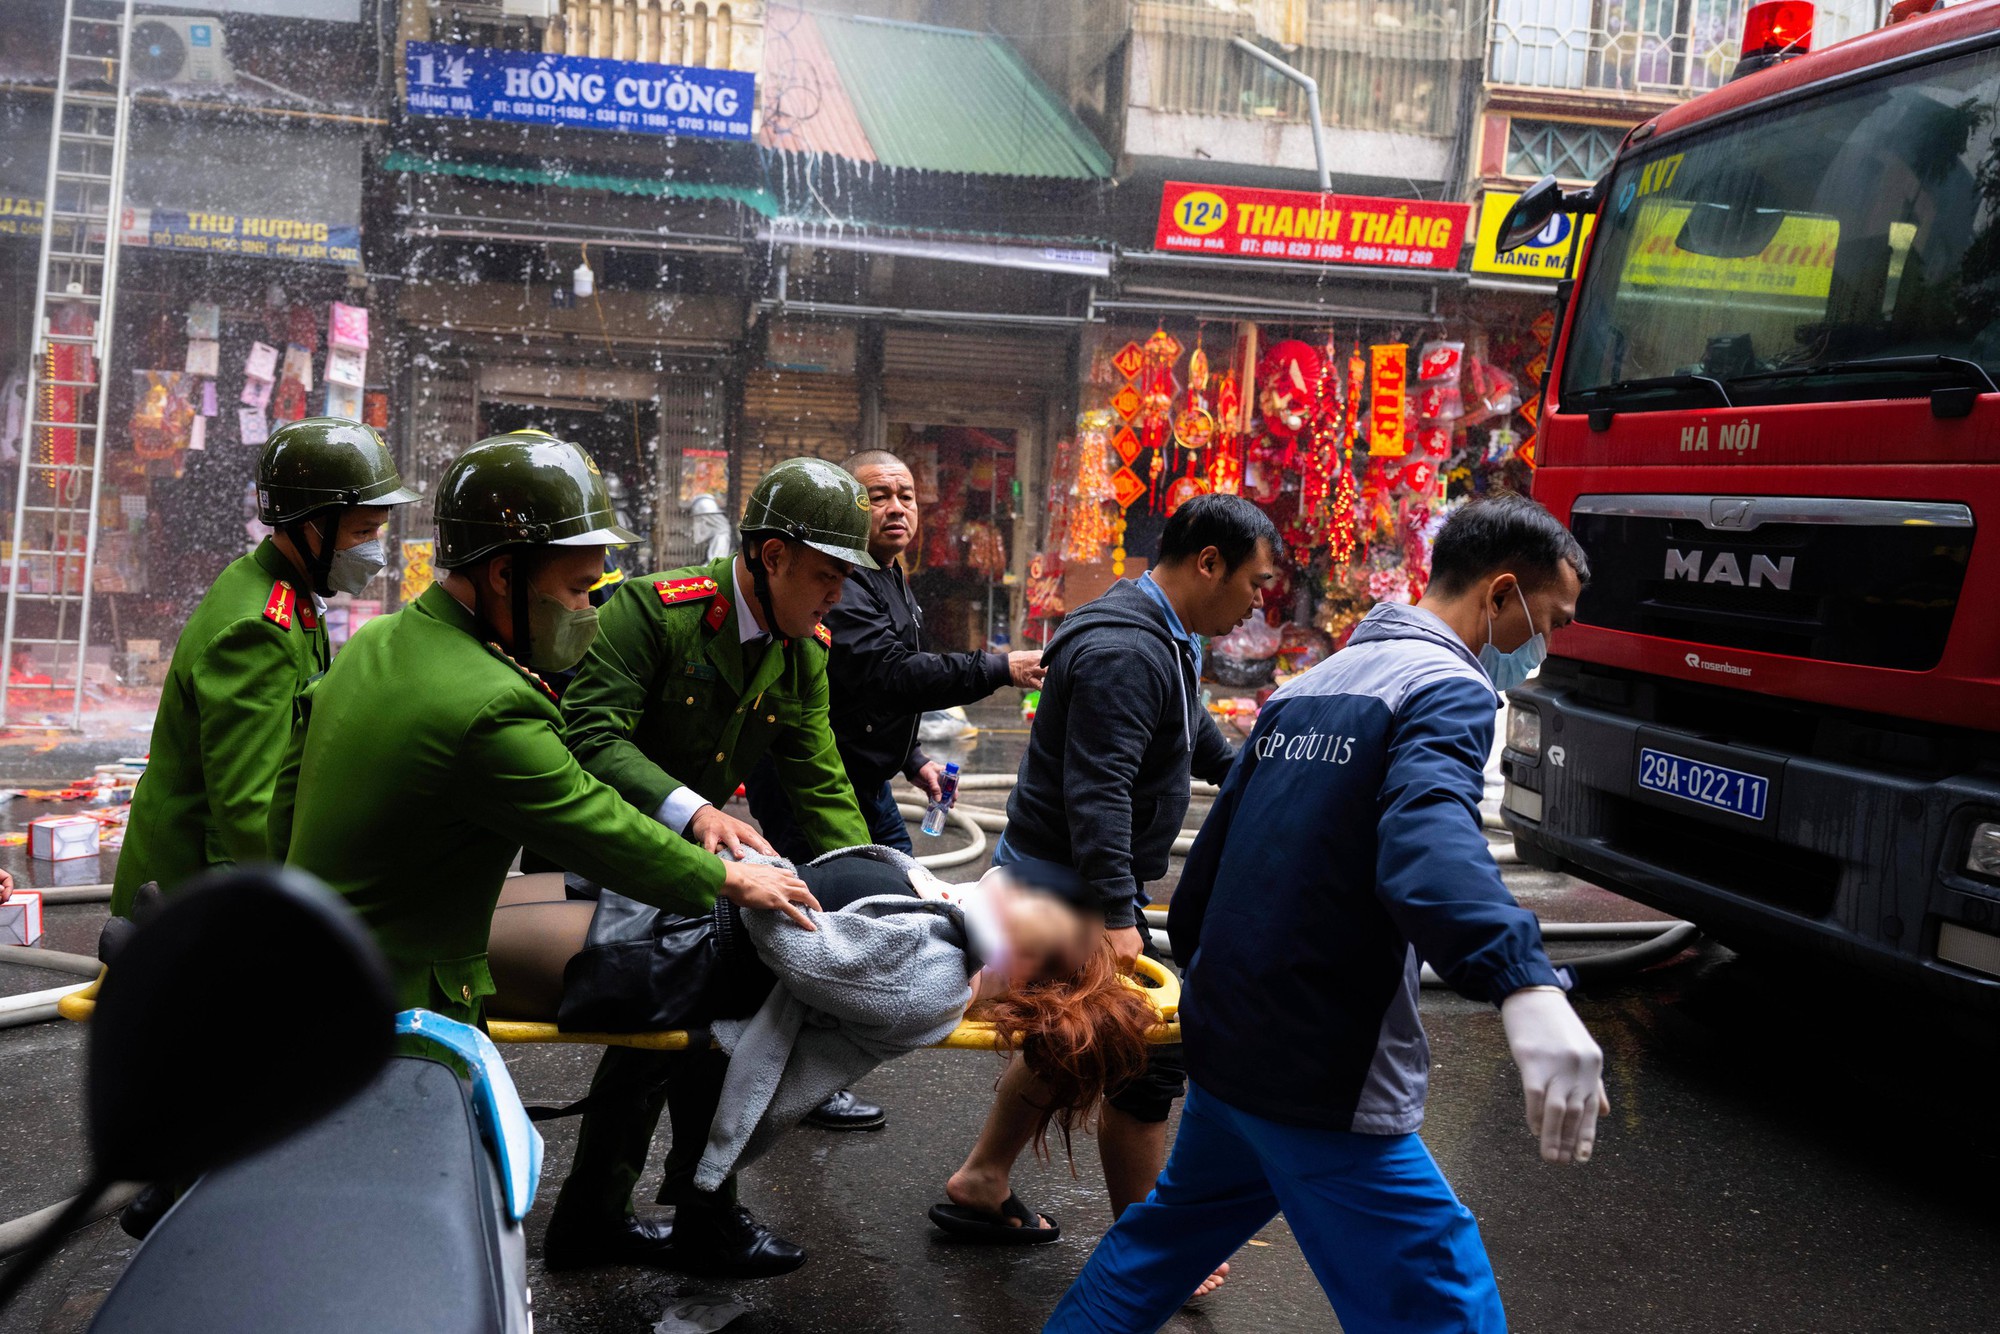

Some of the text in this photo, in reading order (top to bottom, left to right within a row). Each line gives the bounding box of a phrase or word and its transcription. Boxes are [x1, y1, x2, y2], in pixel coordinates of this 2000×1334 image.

[614, 72, 739, 117] CƯỜNG
[1637, 153, 1685, 198] KV7
[1184, 201, 1453, 249] 12A THANH THẮNG
[1680, 417, 1760, 456] HÀ NỘI
[1664, 549, 1795, 591] MAN
[1700, 660, 1752, 677] rosenbauer
[1284, 726, 1325, 761] CỨU
[1321, 734, 1356, 765] 115
[1642, 754, 1760, 814] 29A-022.11
